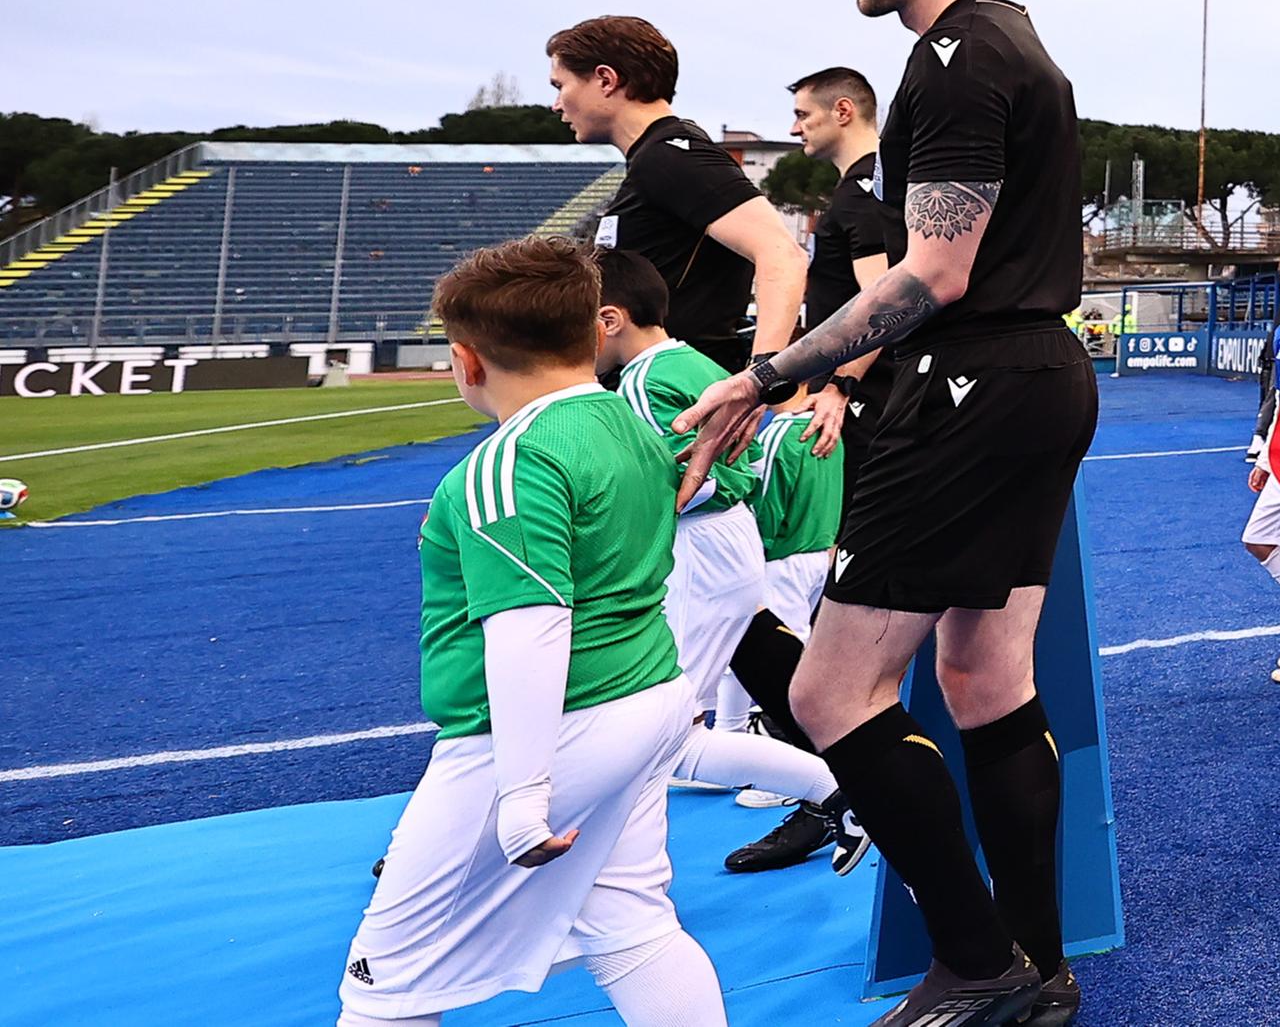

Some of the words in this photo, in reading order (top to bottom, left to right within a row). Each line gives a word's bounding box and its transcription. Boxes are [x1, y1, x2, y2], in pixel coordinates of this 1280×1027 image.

[1127, 355, 1197, 369] empolifc.com
[1217, 337, 1246, 372] EMPOLI
[14, 359, 199, 397] CKET
[347, 966, 374, 986] adidas
